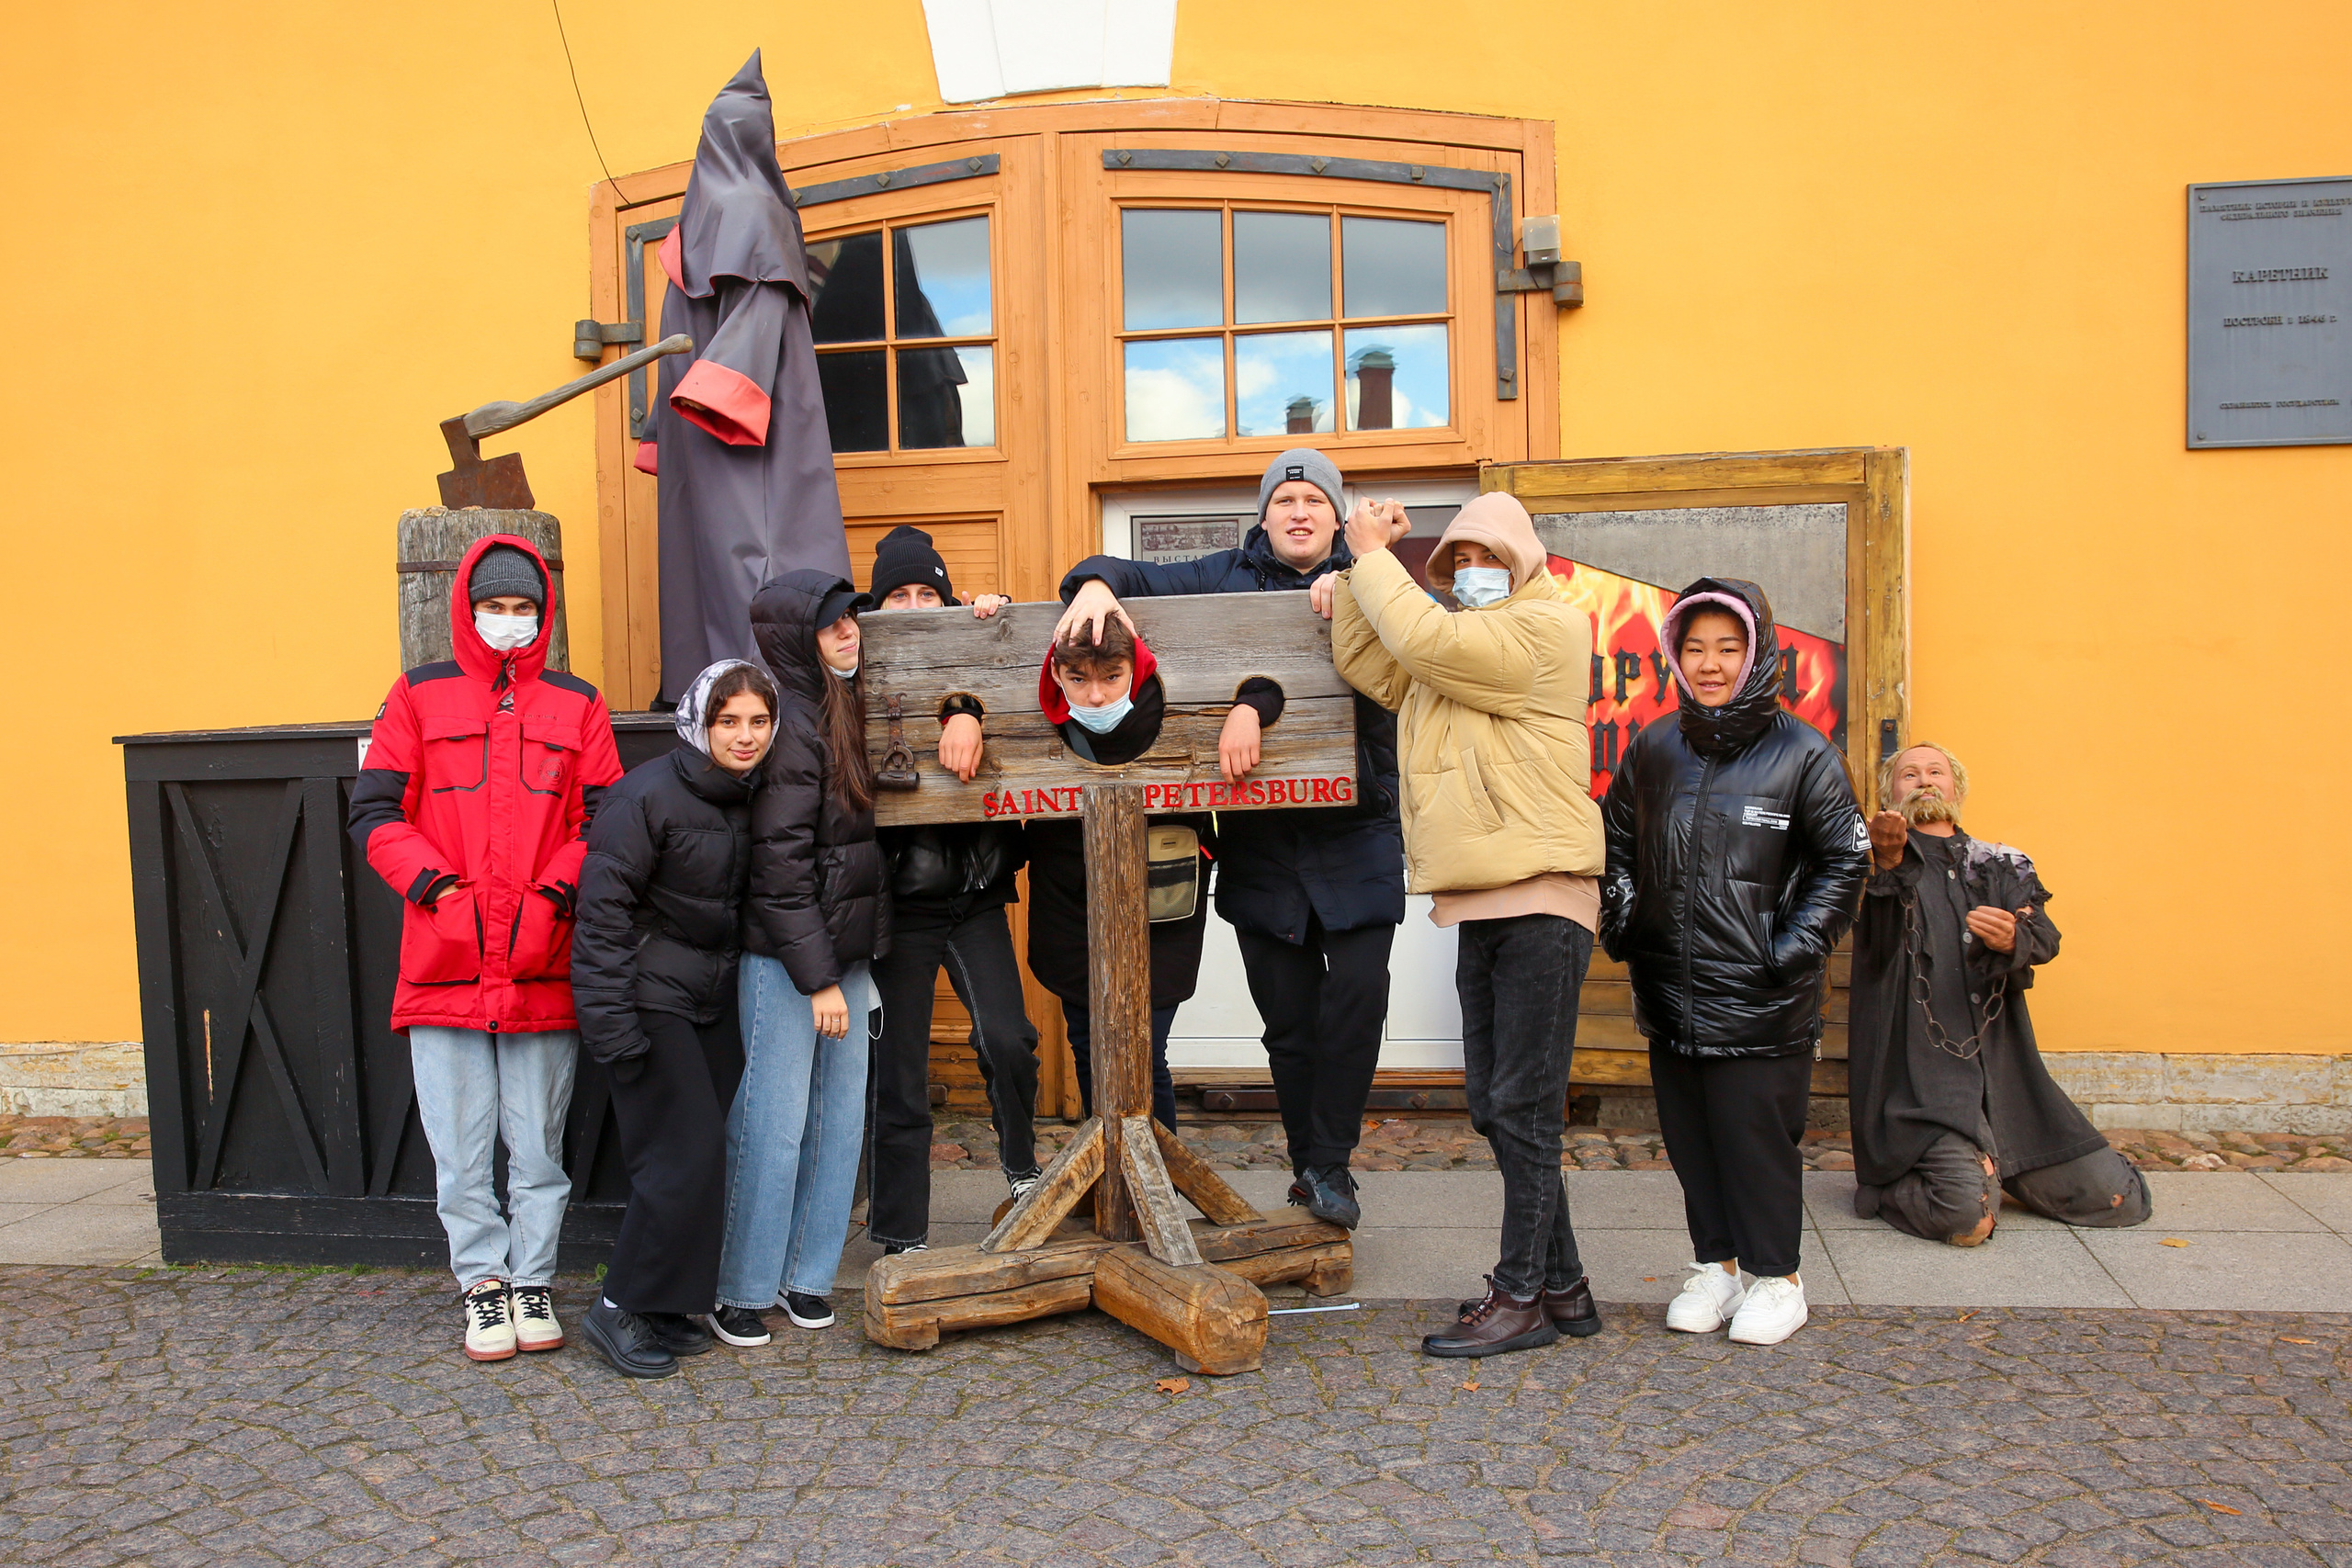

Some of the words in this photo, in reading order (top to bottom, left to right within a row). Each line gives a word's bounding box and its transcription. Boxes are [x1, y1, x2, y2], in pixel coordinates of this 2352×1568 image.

[2233, 267, 2329, 283] КАРЕТНИК
[2223, 316, 2284, 327] ПОСТРОЕН
[983, 786, 1082, 817] SAINT
[1143, 776, 1352, 808] PETERSBURG
